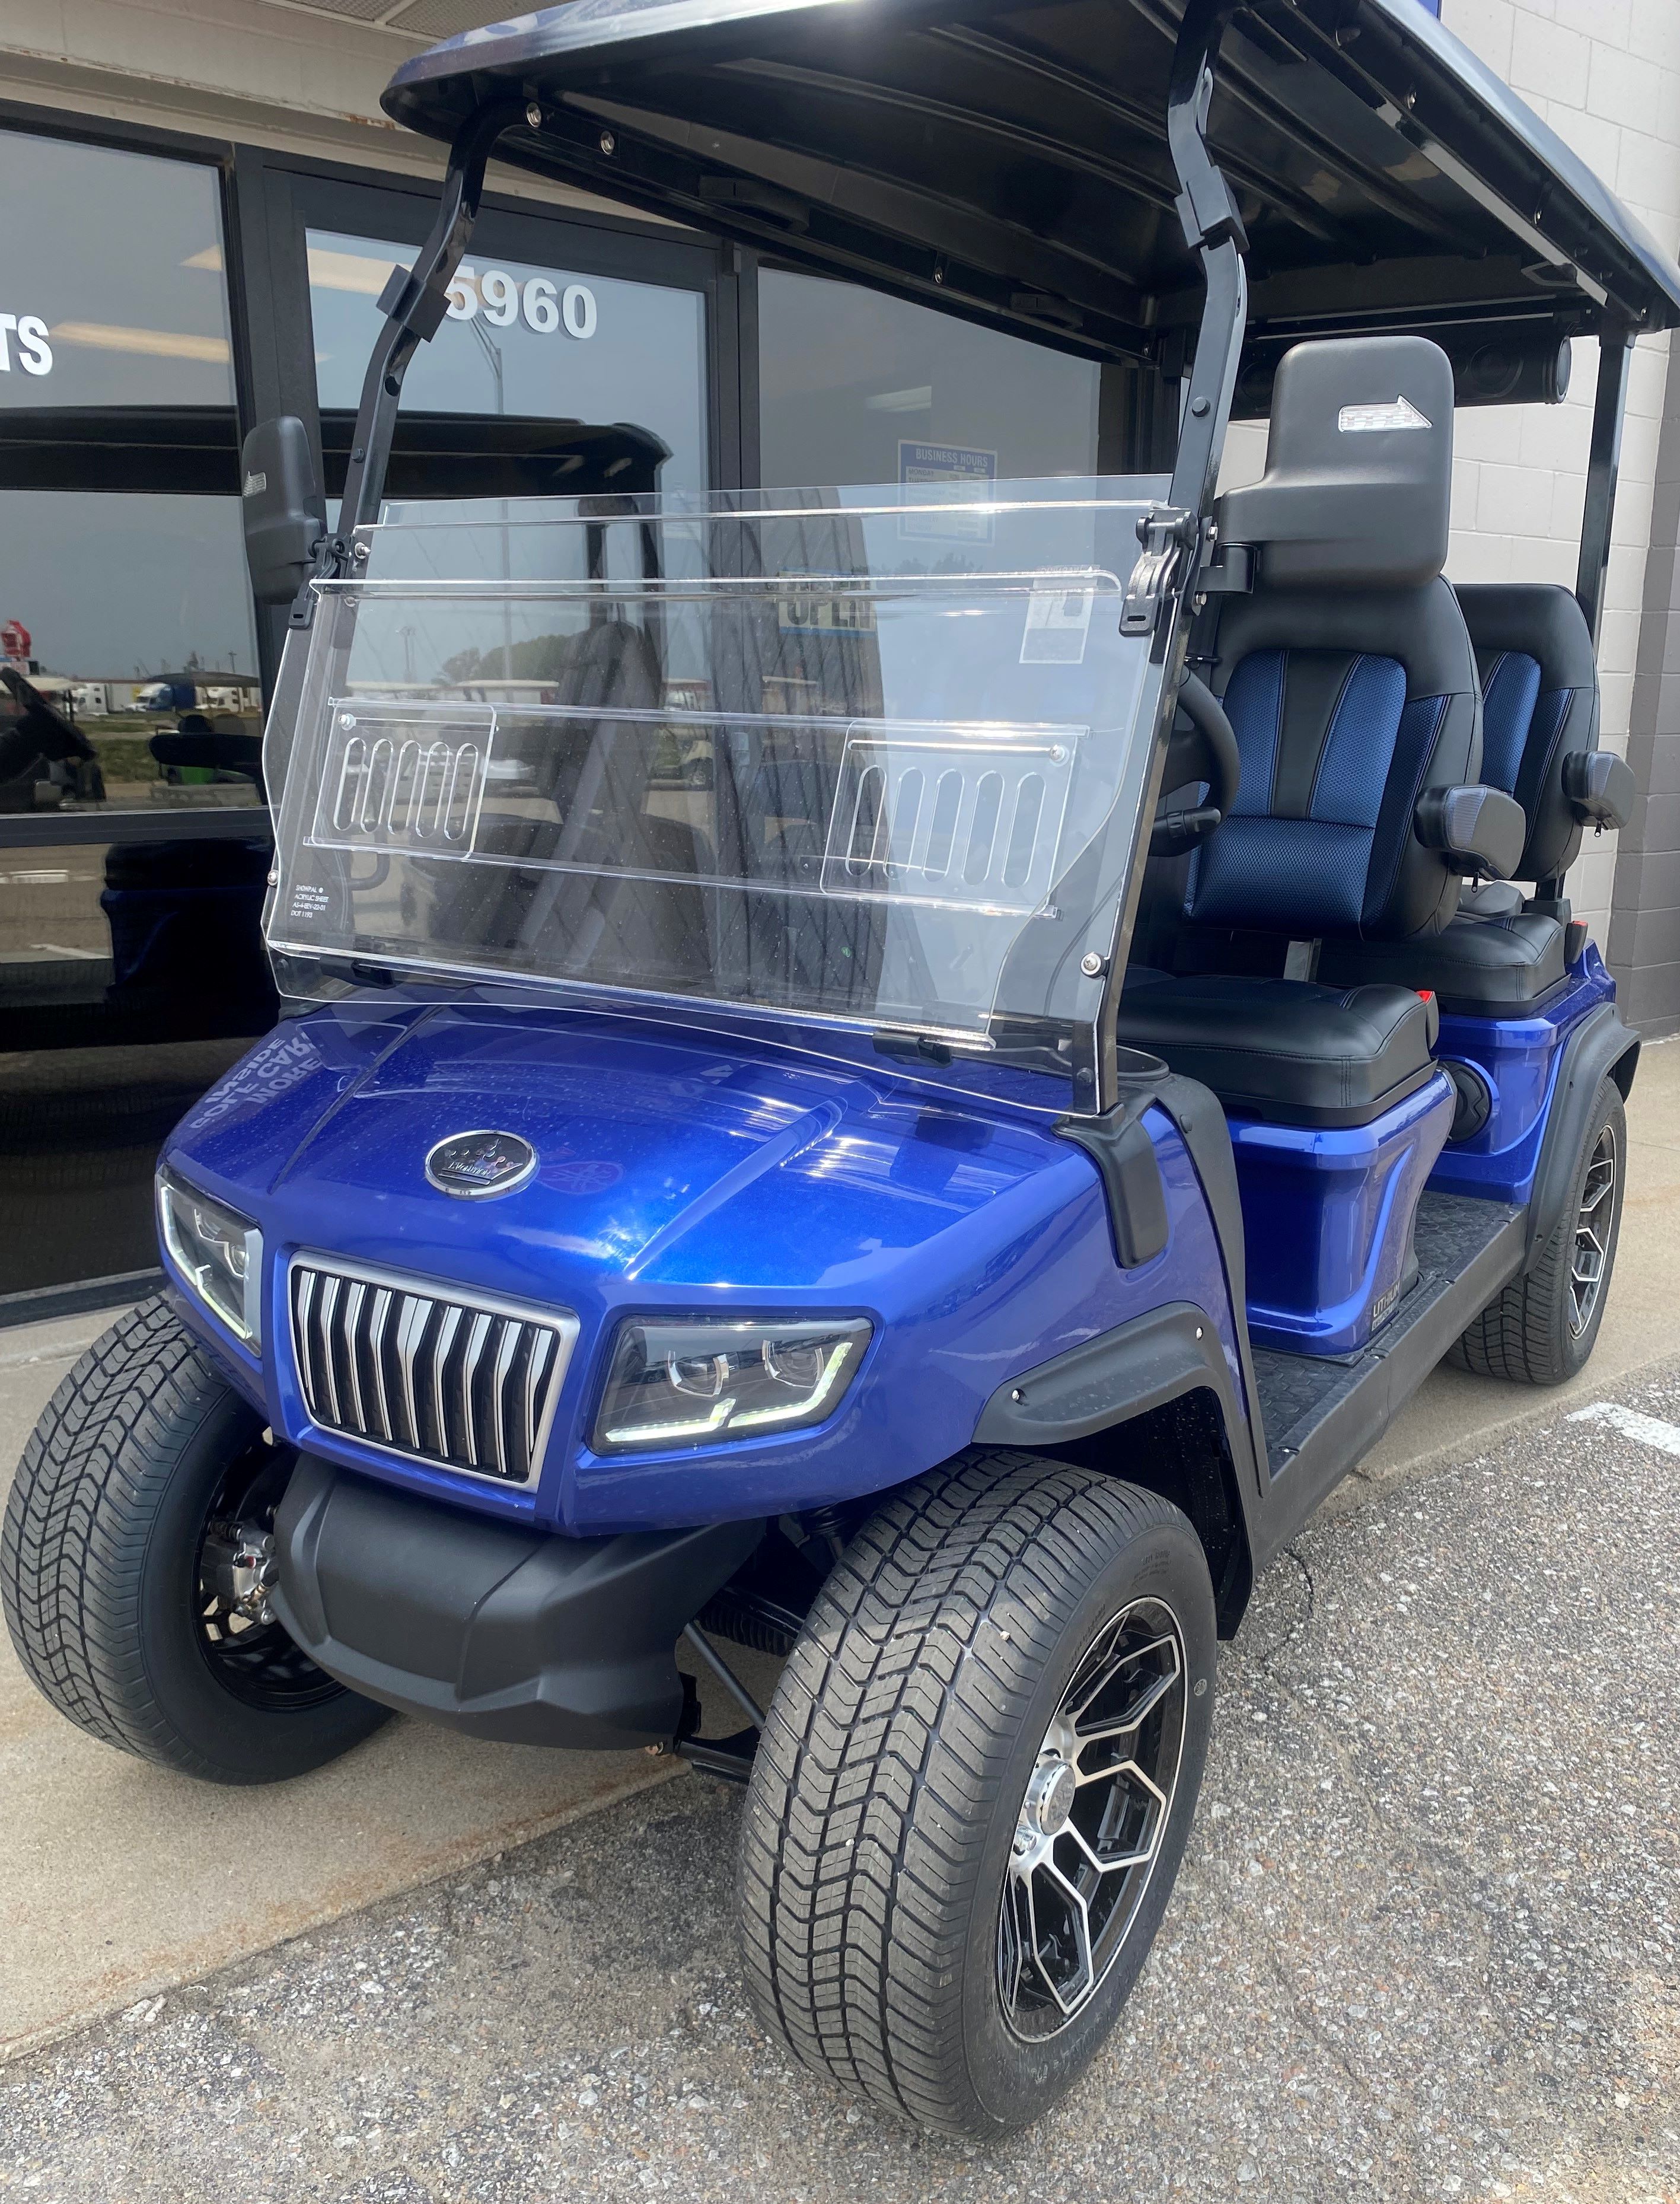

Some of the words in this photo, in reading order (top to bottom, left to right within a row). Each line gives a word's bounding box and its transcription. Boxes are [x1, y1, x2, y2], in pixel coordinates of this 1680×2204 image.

[444, 265, 597, 339] 5960
[915, 448, 958, 463] BUSINESS
[960, 453, 988, 467] HOURS
[1373, 1278, 1400, 1318] LITHIUM
